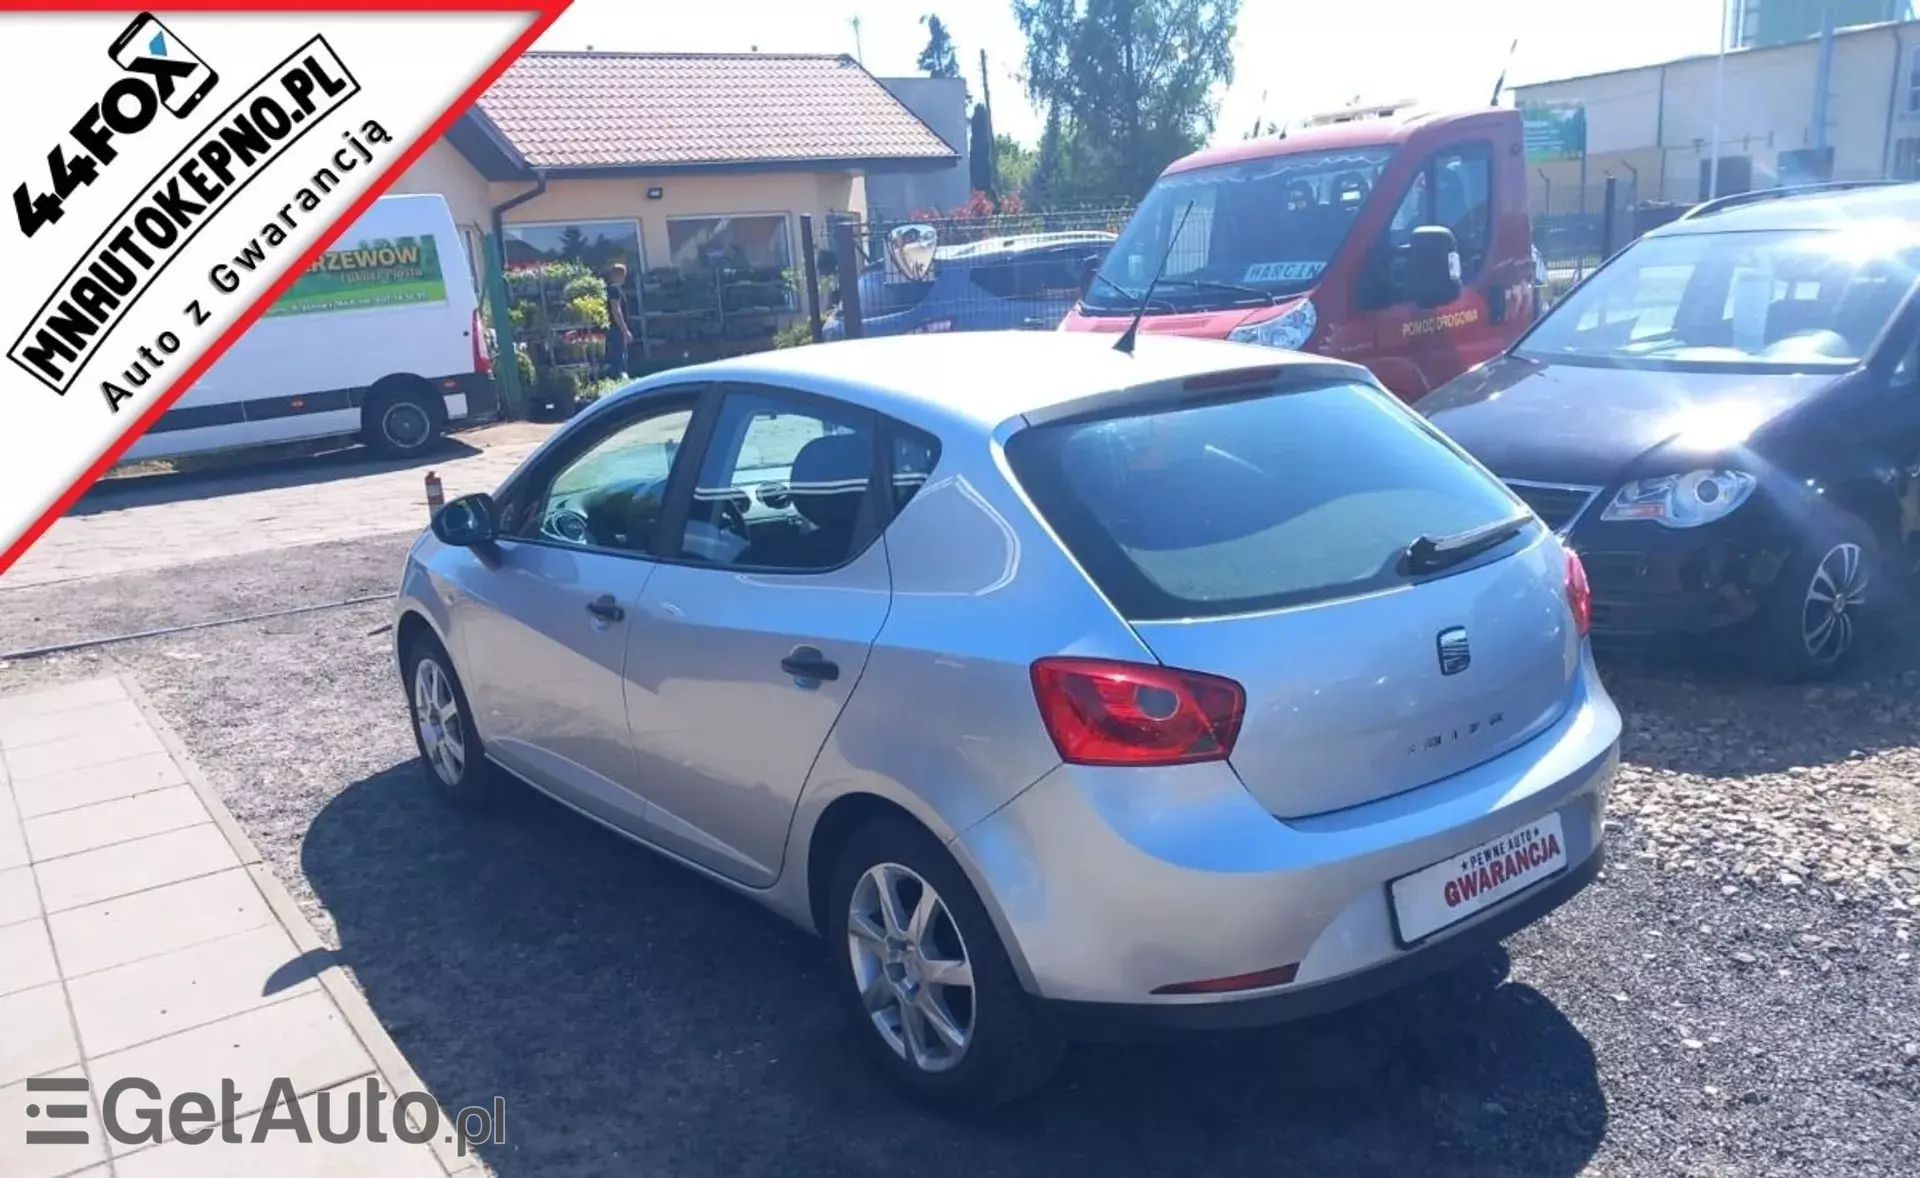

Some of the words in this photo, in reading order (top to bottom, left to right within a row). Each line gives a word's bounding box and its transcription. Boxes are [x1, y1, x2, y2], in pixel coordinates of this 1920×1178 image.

[1402, 318, 1435, 338] POMOC
[1470, 842, 1506, 869] PEWNE
[1508, 829, 1532, 851] AUTO
[1444, 833, 1561, 908] GWARANCJA
